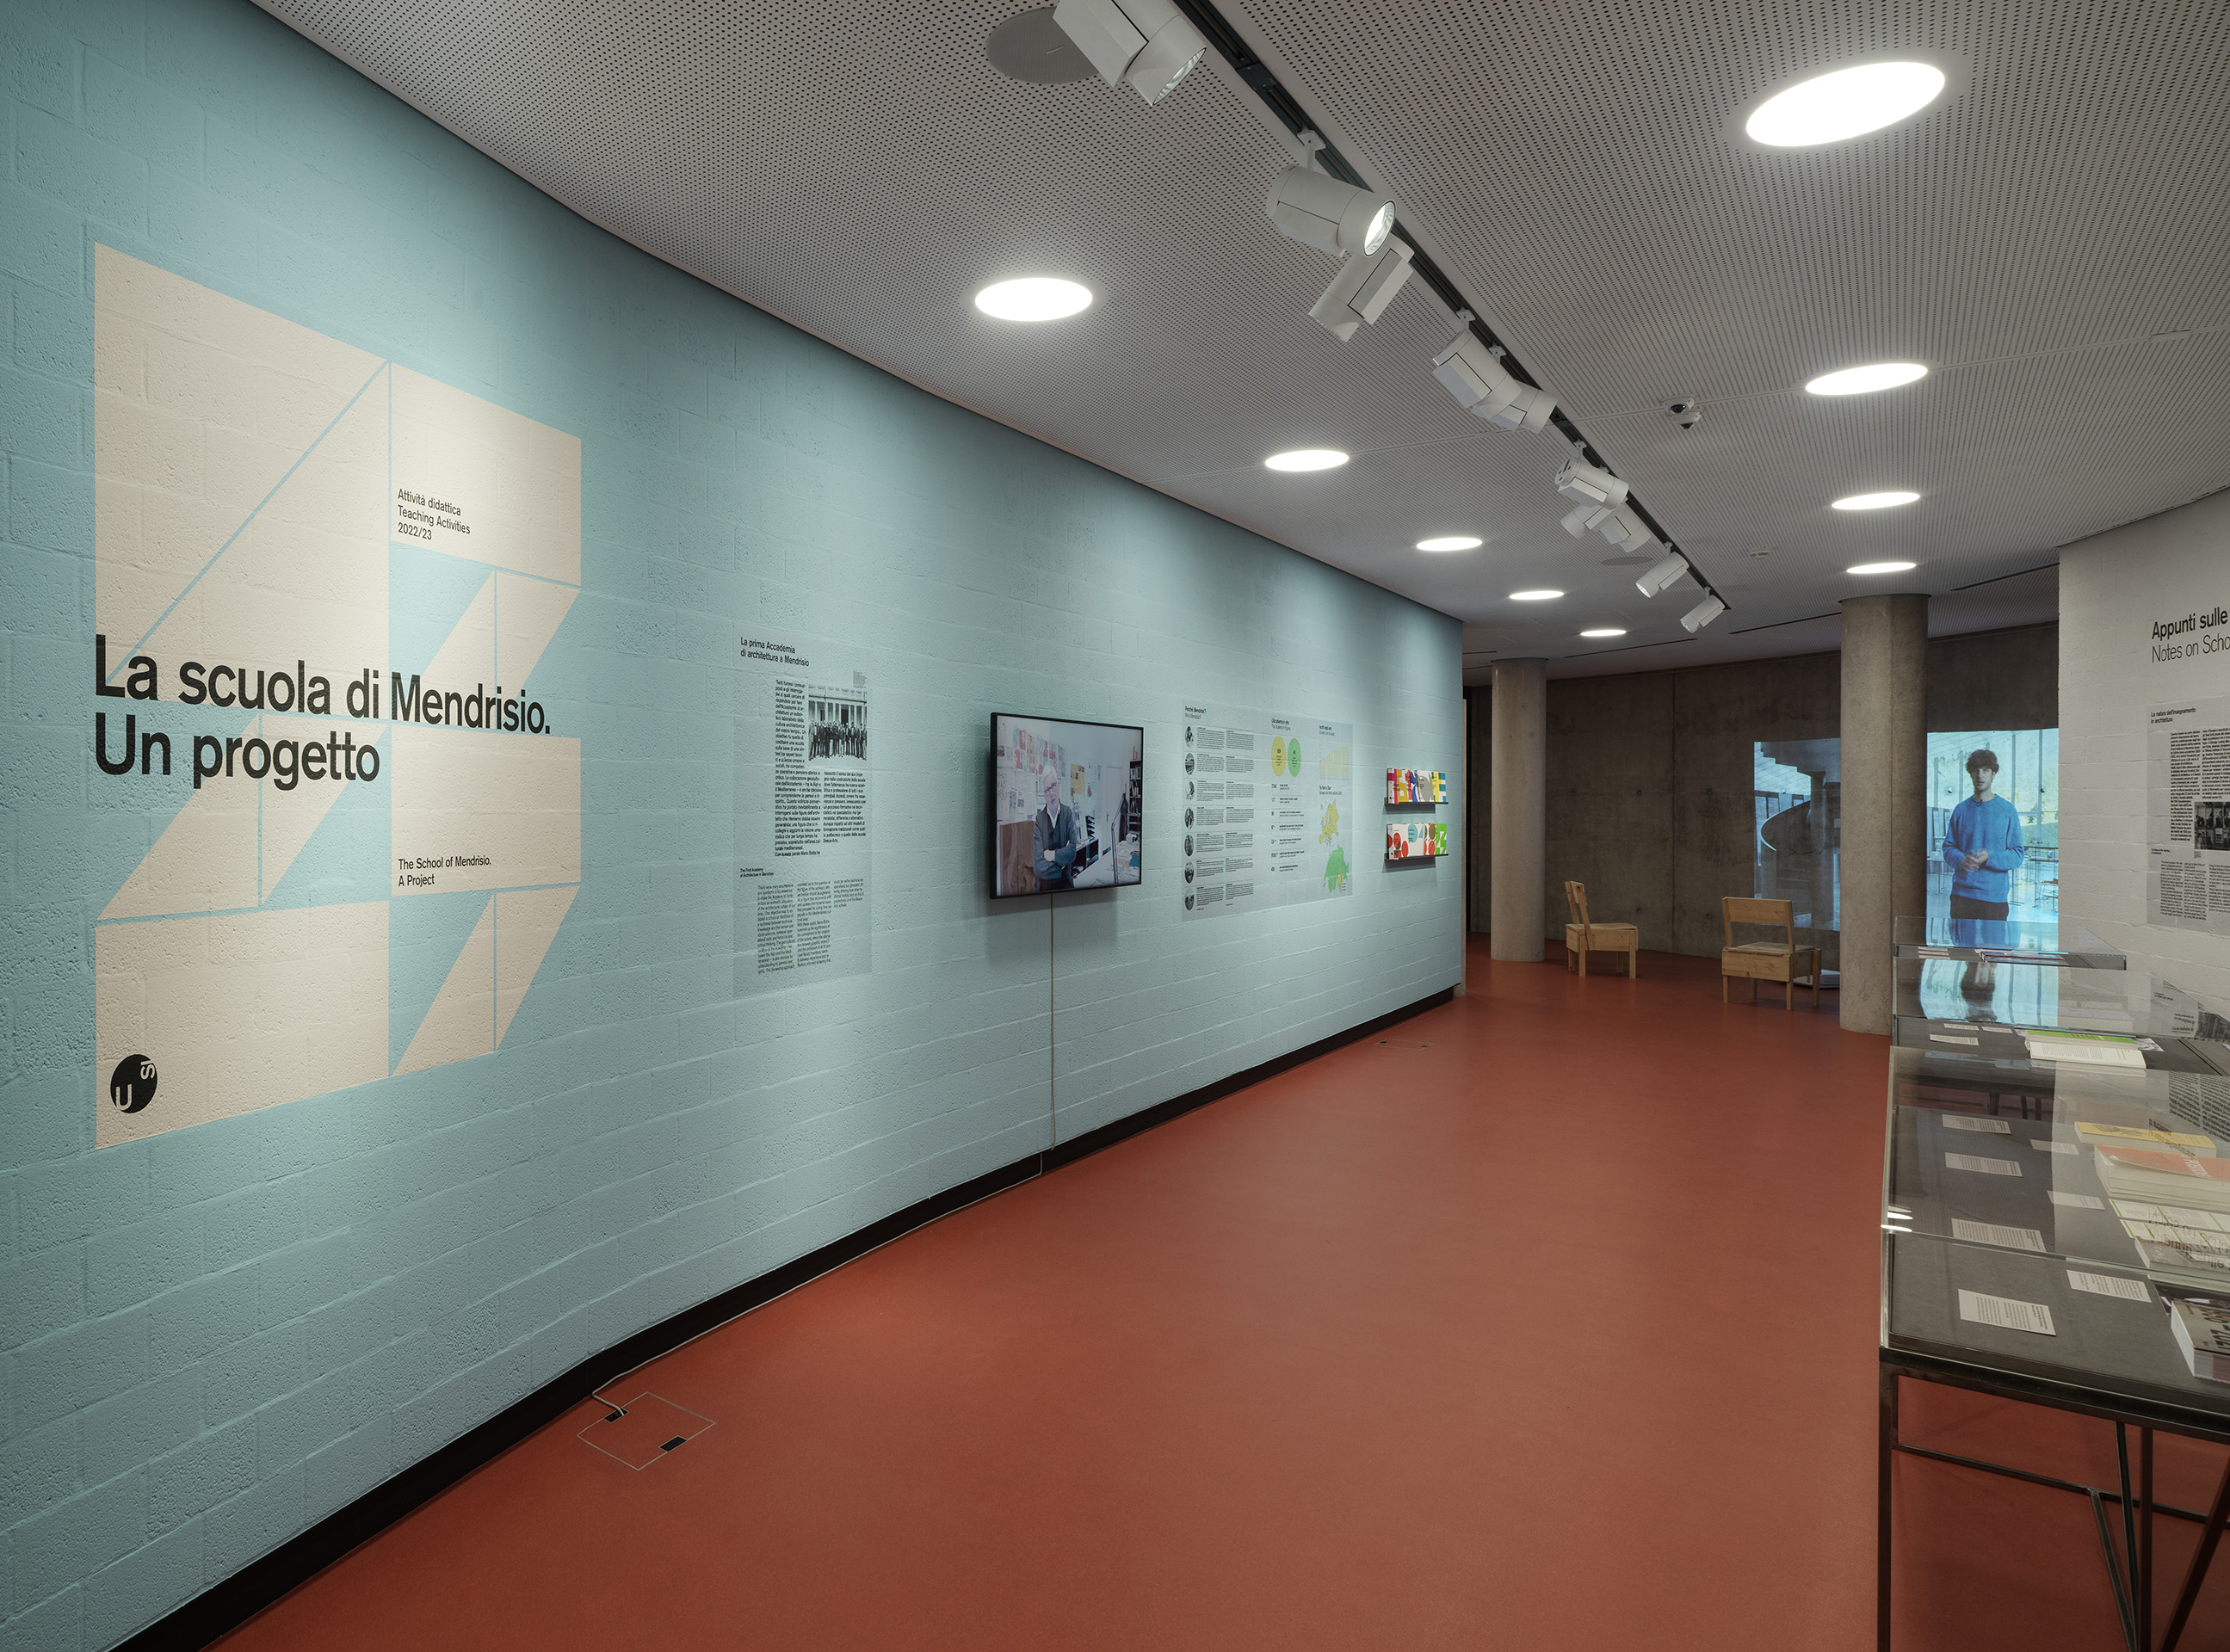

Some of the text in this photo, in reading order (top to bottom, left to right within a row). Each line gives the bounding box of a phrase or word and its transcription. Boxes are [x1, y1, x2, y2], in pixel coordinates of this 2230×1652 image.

[398, 488, 461, 516] Attività didattica
[398, 504, 471, 534] Teaching Activities
[398, 521, 432, 540] 2022/23
[2152, 607, 2228, 641] Appunti sulle
[741, 637, 796, 654] La prima Accademia
[2152, 643, 2183, 663] Notes
[2186, 642, 2199, 656] on
[740, 648, 746, 656] di
[747, 650, 779, 663] architettura
[784, 655, 809, 667] Mendrisio
[96, 634, 551, 734] La scuola di Mendrisio.
[96, 712, 380, 792] Un progetto
[398, 855, 491, 870] The School of Mendrisio.
[398, 873, 435, 887] A Project
